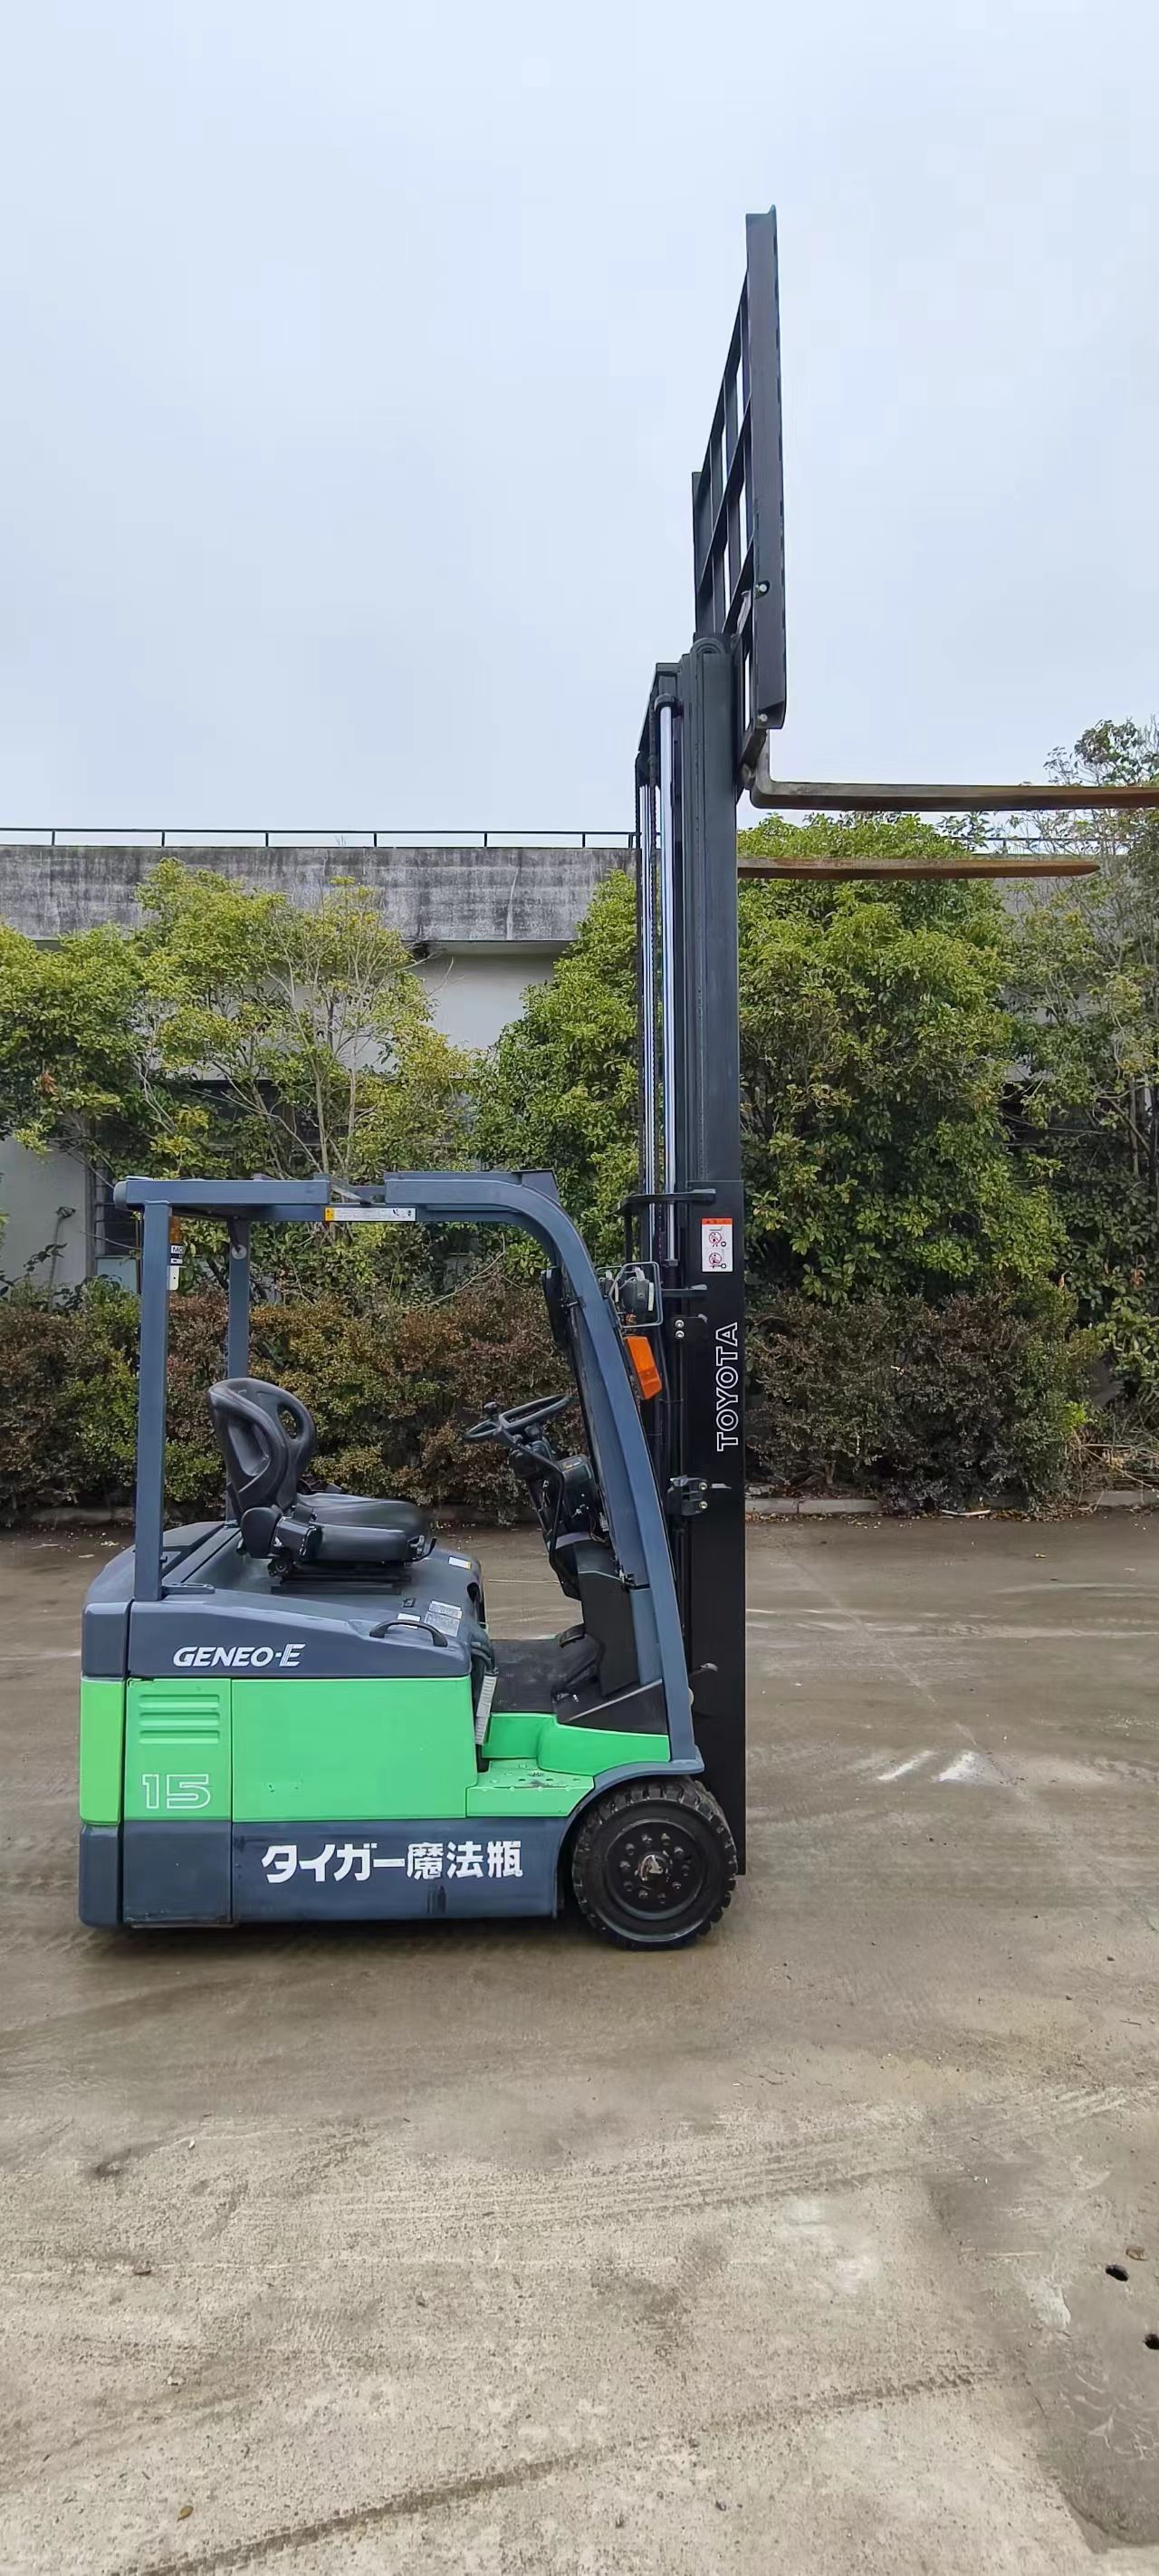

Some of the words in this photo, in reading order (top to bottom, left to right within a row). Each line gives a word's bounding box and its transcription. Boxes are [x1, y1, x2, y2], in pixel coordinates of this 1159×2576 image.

[715, 1322, 739, 1452] TOYOTA
[142, 1773, 211, 1809] 15
[261, 1841, 523, 1884] タイガー魔法瓶
